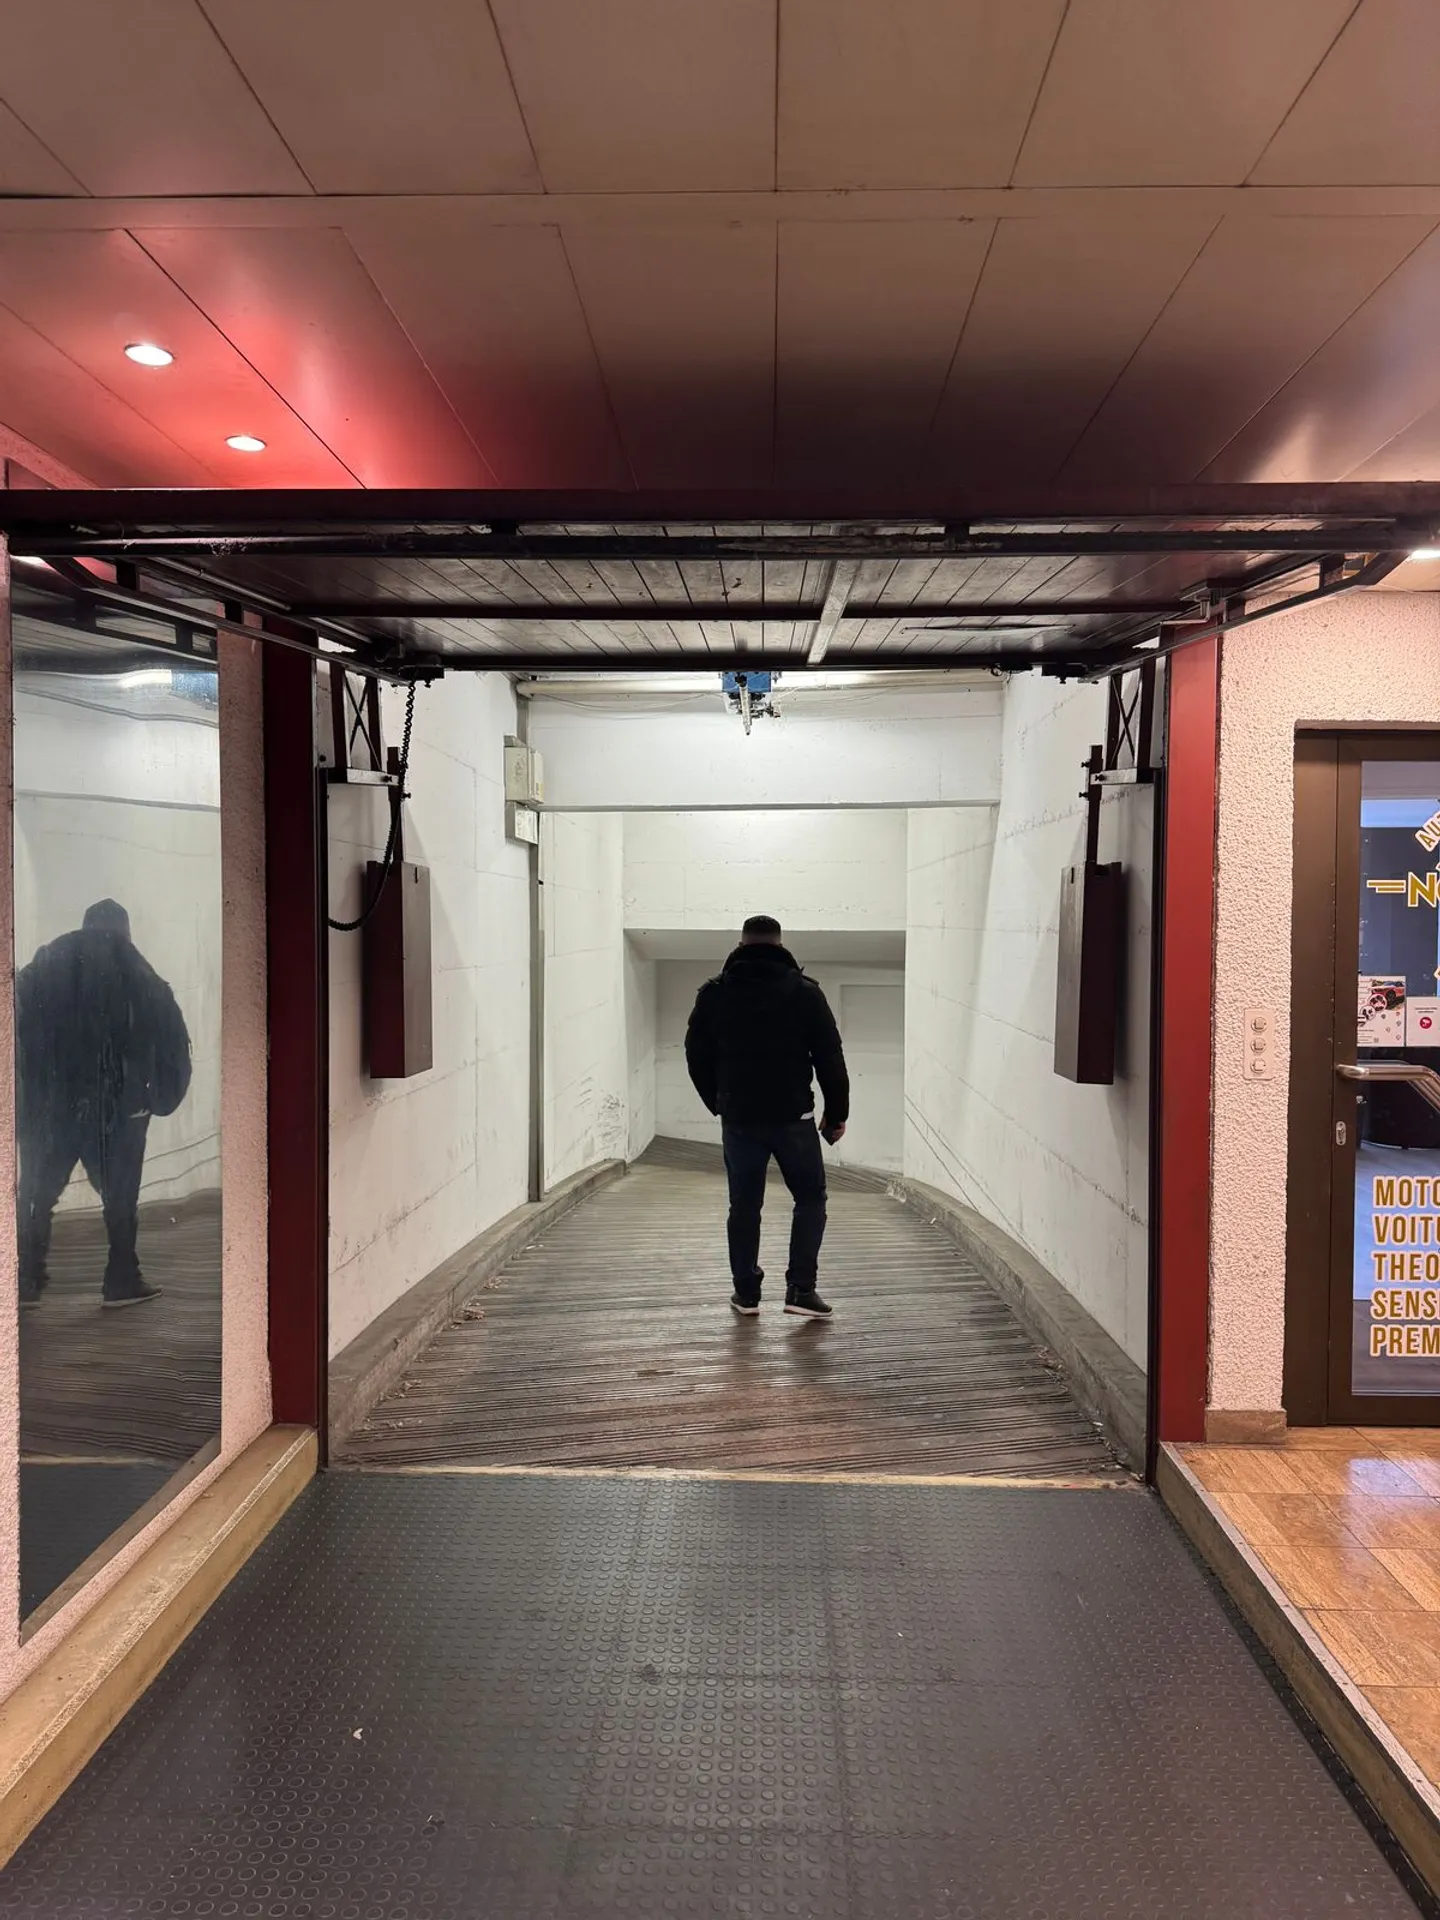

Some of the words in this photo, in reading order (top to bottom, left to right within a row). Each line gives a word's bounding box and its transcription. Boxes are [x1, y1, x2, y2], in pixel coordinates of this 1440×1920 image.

[1418, 812, 1440, 848] AU
[1409, 873, 1440, 907] N
[1373, 1215, 1440, 1244] VOIT
[1373, 1253, 1440, 1281] THEO
[1372, 1326, 1440, 1354] PREM
